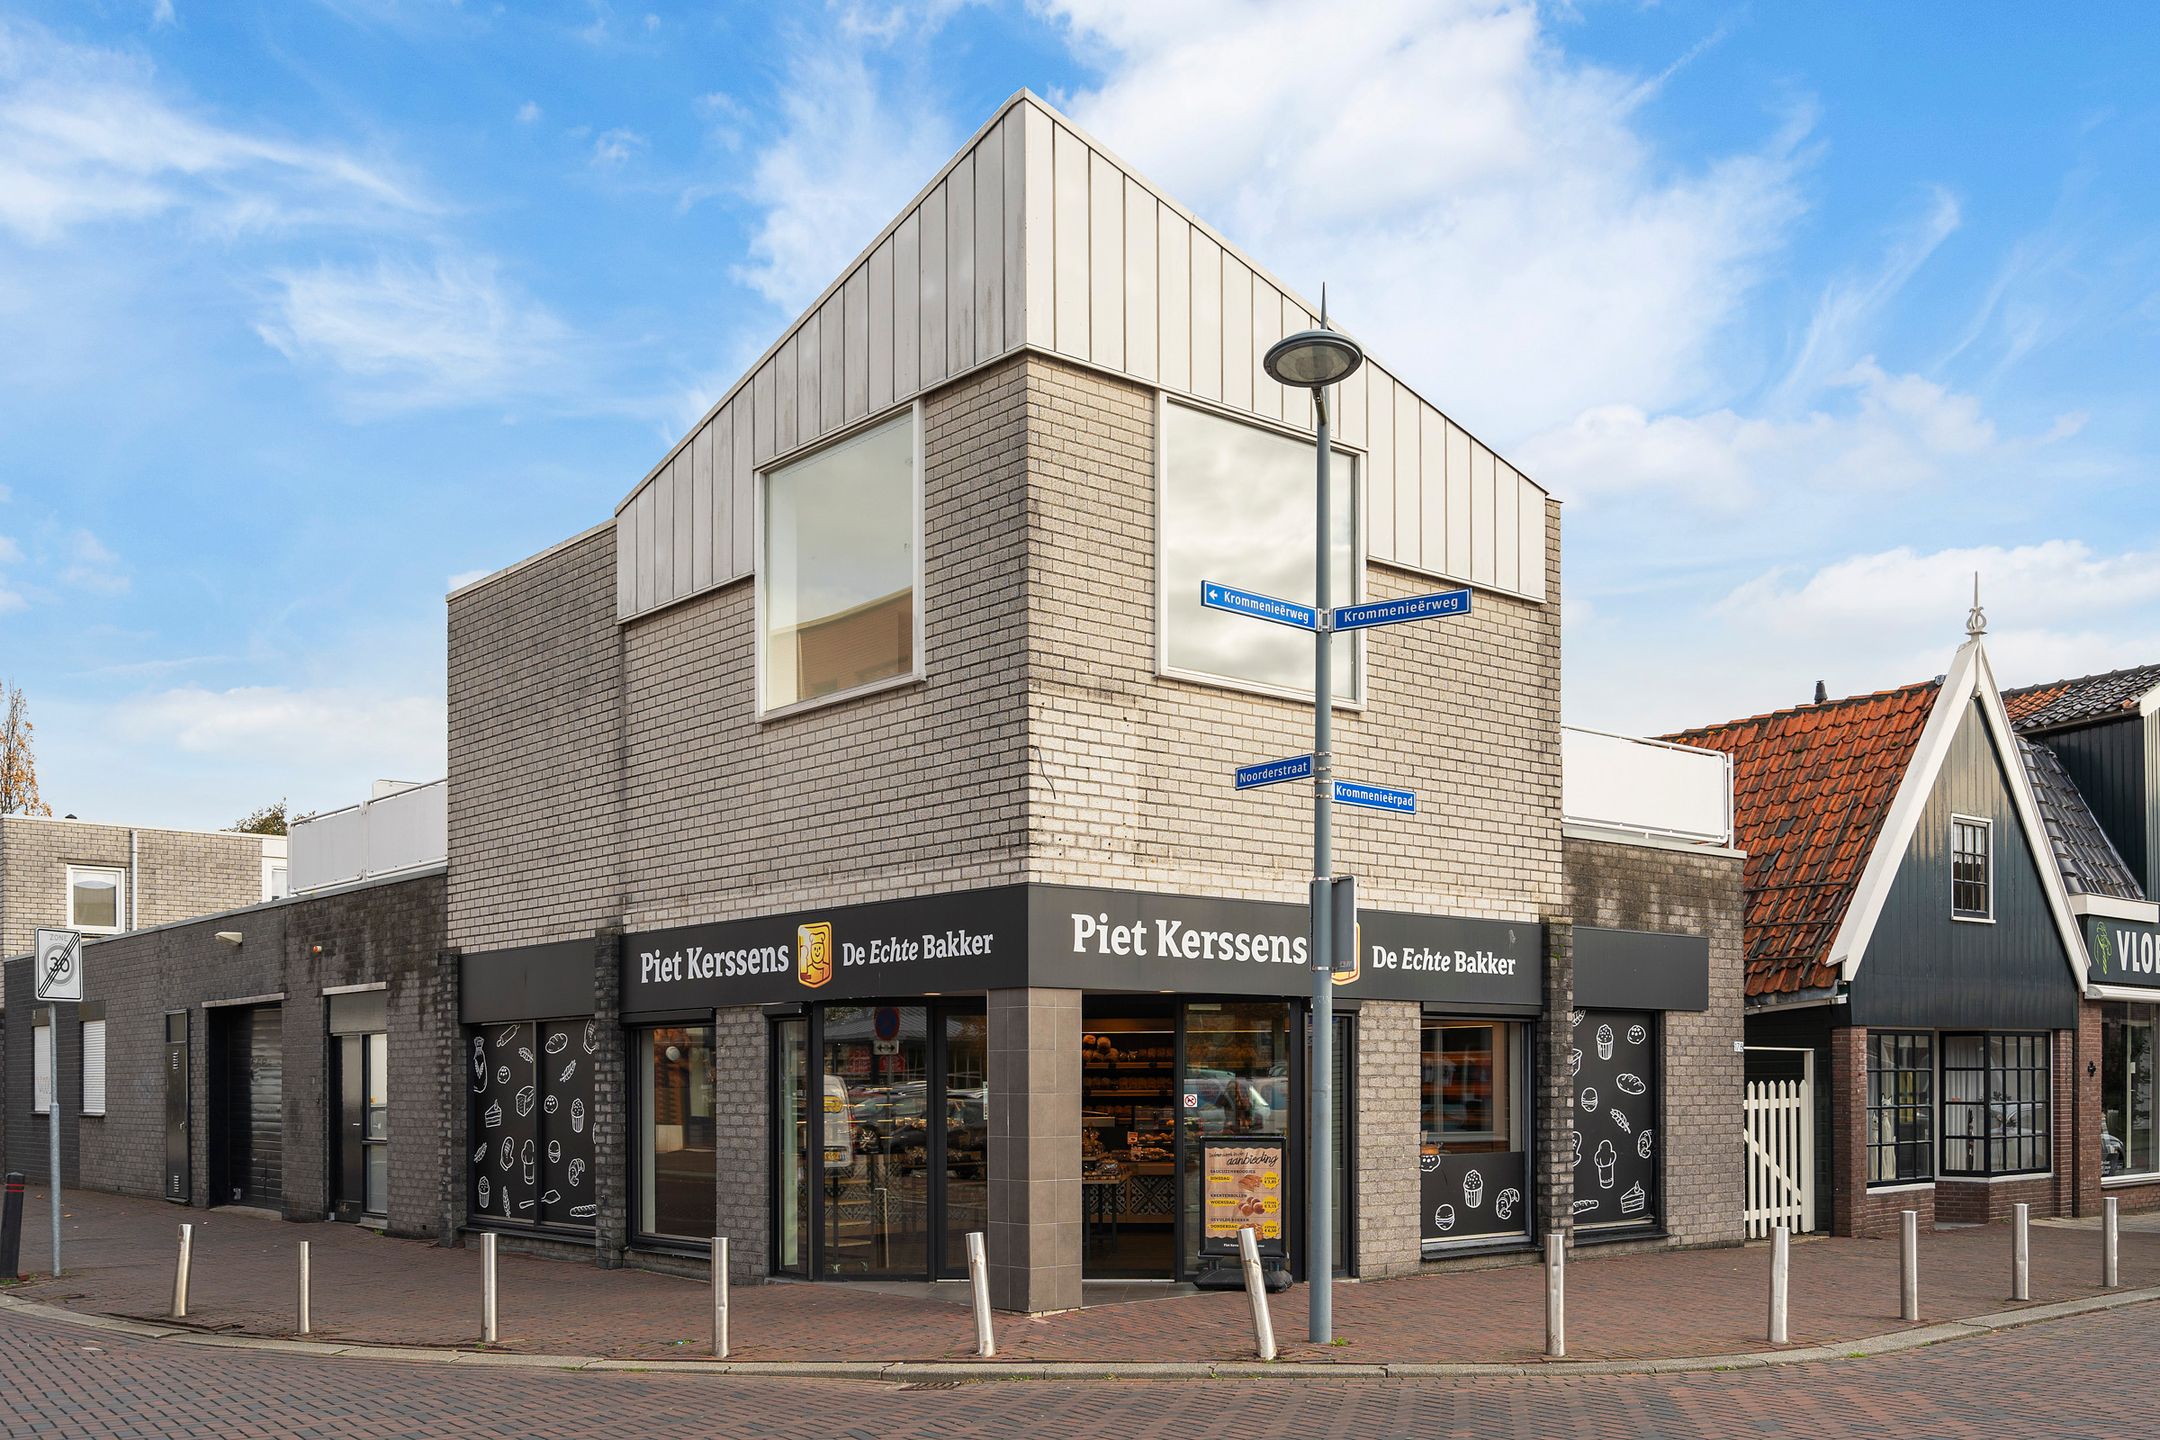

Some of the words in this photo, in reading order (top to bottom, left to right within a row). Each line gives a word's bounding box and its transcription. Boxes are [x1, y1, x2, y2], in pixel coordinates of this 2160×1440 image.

[1223, 590, 1310, 624] Krommenieërweg
[1343, 596, 1459, 623] Krommenieërweg
[1239, 761, 1308, 783] Noorderstraat
[1335, 783, 1414, 808] Krommenieërpad
[49, 933, 69, 942] ZONE
[842, 942, 867, 967] De
[869, 936, 919, 964] Echte
[922, 929, 994, 959] Bakker
[1071, 912, 1148, 956] Piet
[1155, 919, 1308, 965] Kerssens
[49, 956, 70, 973] 30
[640, 949, 682, 984] Piet
[686, 945, 789, 980] Kerssens
[1371, 945, 1398, 970] De
[1401, 947, 1451, 972] Echte
[1453, 950, 1516, 976] Bakker
[1226, 1151, 1279, 1168] aanbieding
